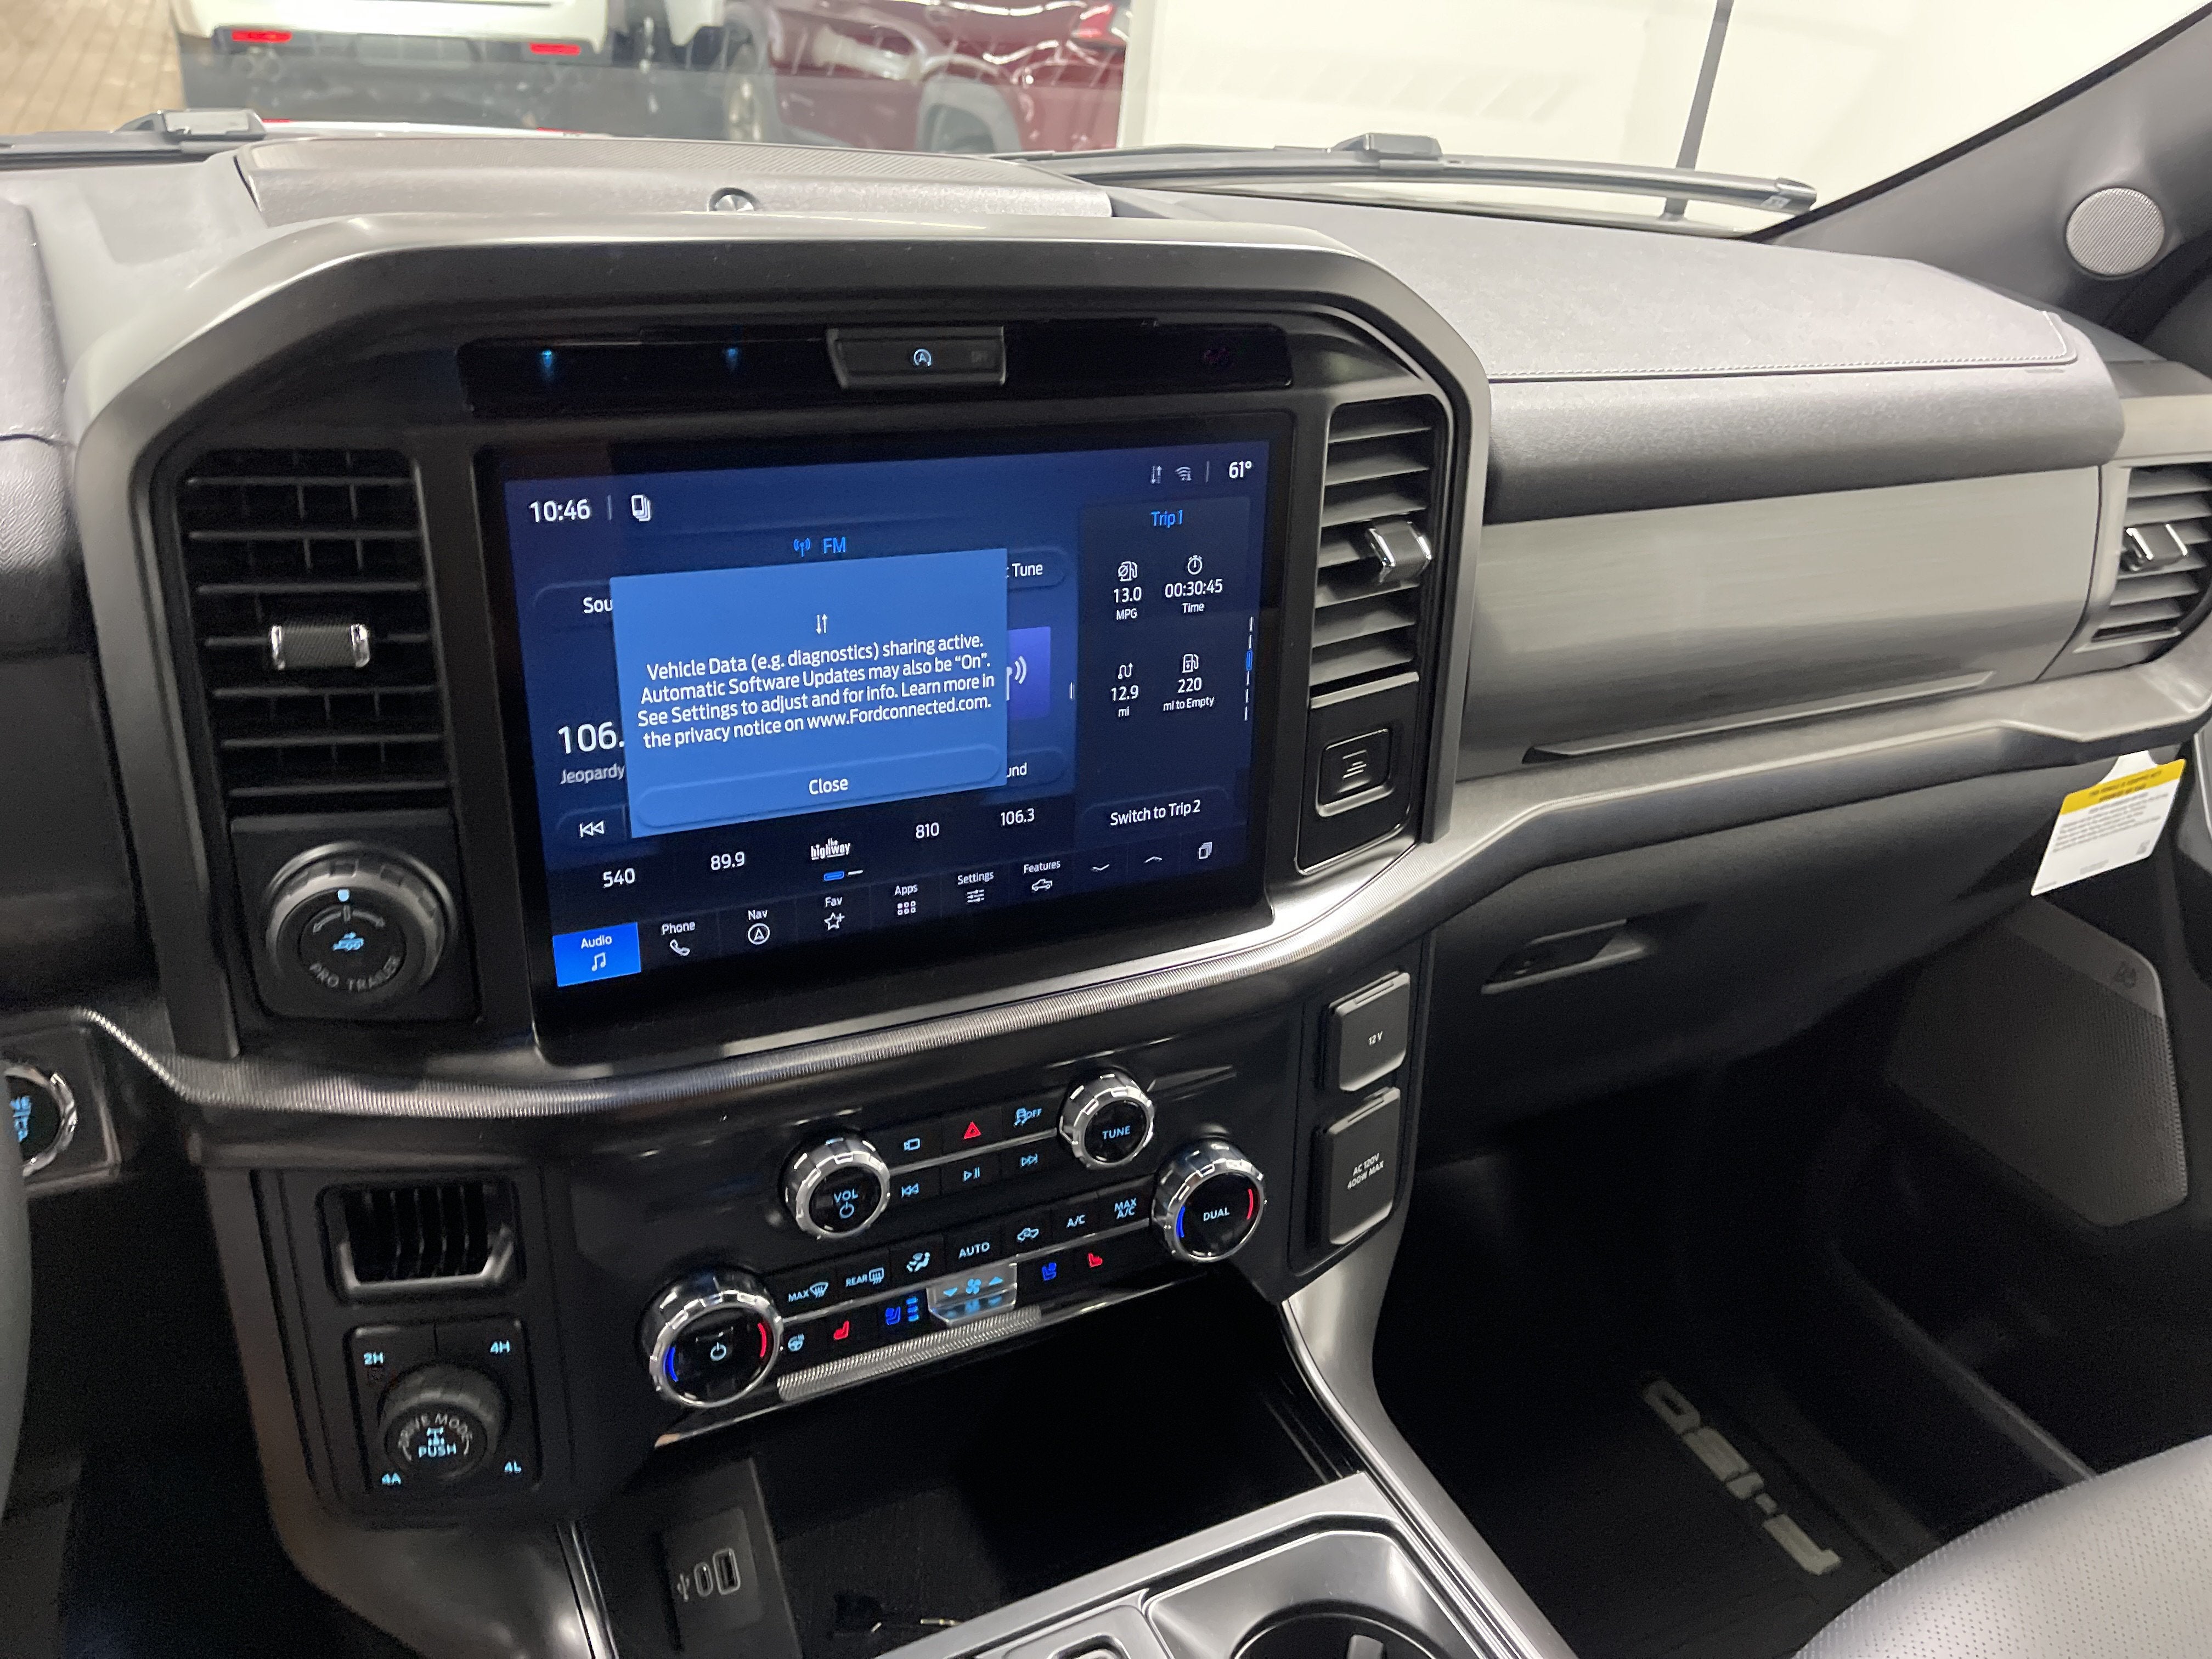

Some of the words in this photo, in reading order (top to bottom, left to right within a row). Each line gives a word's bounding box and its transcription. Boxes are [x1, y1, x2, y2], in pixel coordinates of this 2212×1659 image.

[1228, 460, 1252, 479] 61°
[529, 499, 591, 522] 10:46
[1151, 510, 1177, 528] Trip
[823, 537, 847, 554] FM
[1011, 562, 1043, 577] Tune
[1113, 586, 1142, 603] 13.0
[1164, 578, 1223, 599] 00:30:45
[583, 596, 614, 614] Sou
[1182, 602, 1205, 614] Time
[1115, 608, 1138, 621] MPG
[646, 659, 706, 681] Vehicle
[709, 656, 748, 675] Data
[751, 653, 785, 673] (e.g.
[787, 642, 879, 667] diagnostics)
[882, 639, 935, 657] sharing
[938, 634, 984, 652] active.
[641, 680, 725, 704] Automatic
[728, 674, 800, 695] Software
[803, 667, 865, 688] Updates
[868, 664, 899, 681] may
[902, 659, 932, 676] also
[934, 657, 952, 673] be
[1177, 676, 1202, 693] 220
[637, 710, 668, 727] See
[671, 702, 738, 724] Settings
[741, 699, 758, 715] to
[761, 693, 809, 714] adjust
[811, 689, 840, 708] and
[843, 687, 864, 704] for
[866, 684, 899, 701] info.
[901, 681, 940, 697] Learn
[943, 677, 980, 693] more
[982, 673, 995, 687] in
[1110, 684, 1139, 702] 12.9
[1118, 706, 1130, 717] mi
[1163, 700, 1175, 712] mi
[1176, 699, 1185, 709] to
[1186, 696, 1215, 709] Empty
[643, 731, 672, 749] the
[674, 725, 731, 748] privacy
[733, 719, 782, 738] notice
[784, 716, 804, 732] on
[806, 696, 992, 730] www.Fordconnected.com.
[560, 763, 625, 786] Jeopardy
[808, 777, 849, 795] Close
[1000, 808, 1036, 827] 106.3
[1110, 807, 1151, 826] Switch
[1153, 805, 1166, 819] to
[1168, 801, 1192, 817] Trip
[1193, 799, 1201, 813] 2
[915, 822, 940, 840] 810
[827, 837, 838, 846] the
[810, 842, 851, 860] highway
[710, 851, 746, 871] 89.9
[1023, 859, 1062, 876] Features
[603, 867, 636, 888] 540
[956, 870, 994, 887] Settings
[894, 882, 918, 898] Apps
[825, 896, 843, 908] Fav
[747, 909, 768, 920] Nav
[661, 920, 696, 935] Phone
[580, 934, 613, 949] Audio
[1025, 1108, 1042, 1118] OFF
[1102, 1125, 1131, 1141] TUNE
[1352, 1163, 1363, 1177] AC
[1363, 1153, 1380, 1169] 120V
[1368, 1160, 1384, 1177] MAX
[833, 1189, 859, 1203] VOL
[1114, 1198, 1137, 1212] MAX
[1116, 1205, 1135, 1219] A/C
[1066, 1214, 1086, 1229] A/C
[1203, 1207, 1231, 1222] DUAL
[958, 1242, 990, 1259] AUTO
[845, 1273, 868, 1287] REAR
[788, 1288, 810, 1303] MAX
[489, 1339, 511, 1355] 4H
[363, 1351, 384, 1366] 2H
[418, 1442, 457, 1458] PUSH
[504, 1460, 522, 1474] 4L
[381, 1472, 402, 1486] 4A
[1643, 1379, 1842, 1576] F-150
